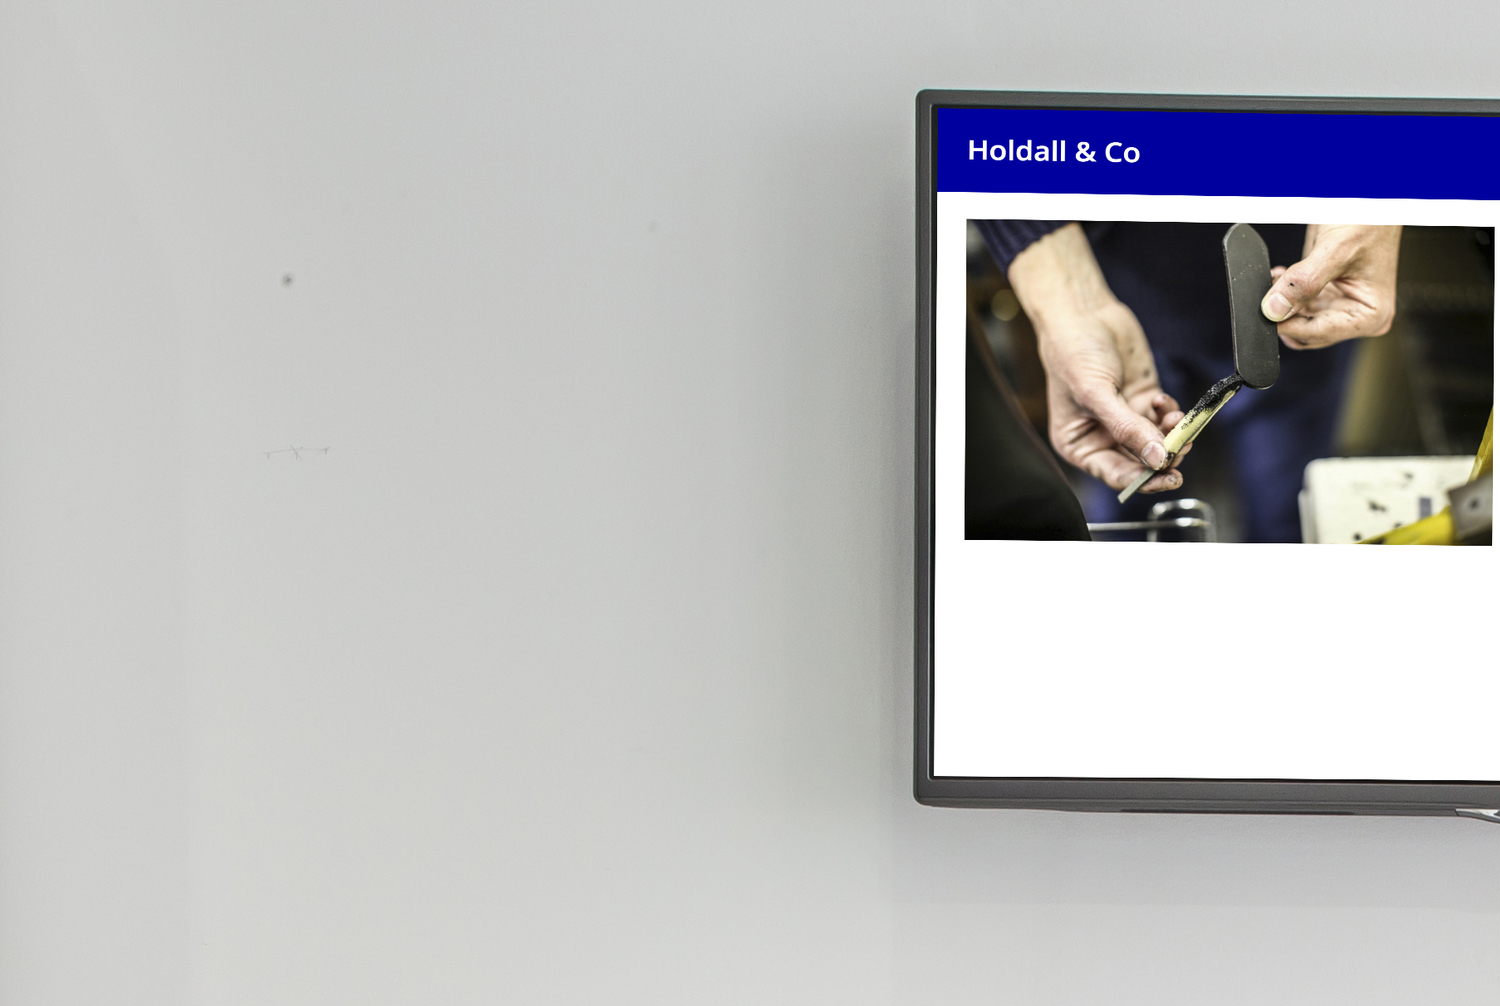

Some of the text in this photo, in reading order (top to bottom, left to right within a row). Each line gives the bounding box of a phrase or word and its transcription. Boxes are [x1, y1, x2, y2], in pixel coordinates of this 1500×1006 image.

[968, 139, 1141, 164] Holdall & Co
